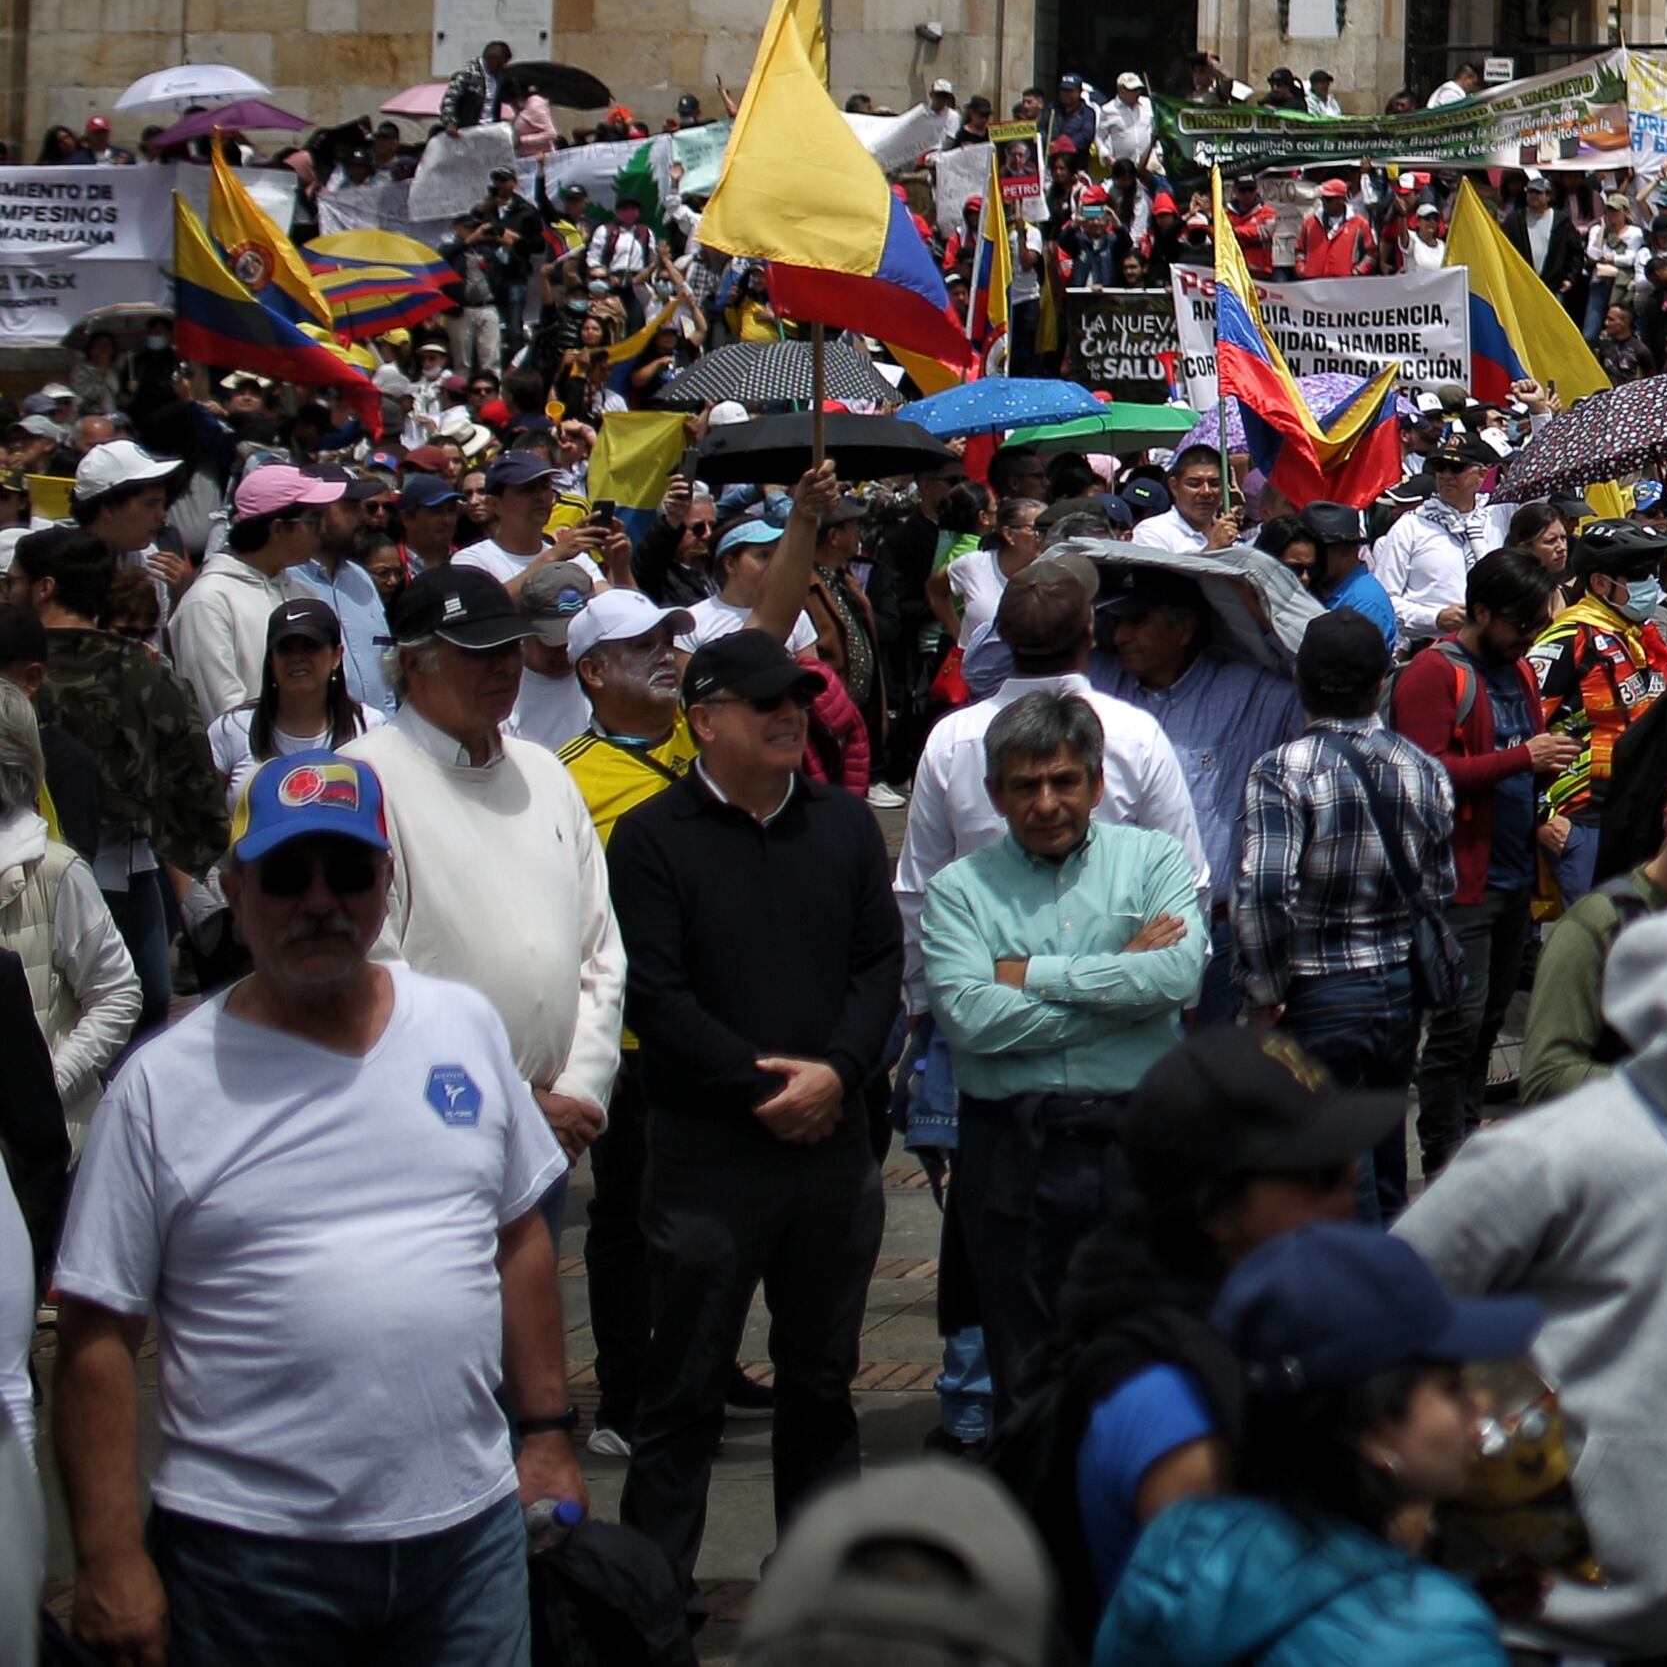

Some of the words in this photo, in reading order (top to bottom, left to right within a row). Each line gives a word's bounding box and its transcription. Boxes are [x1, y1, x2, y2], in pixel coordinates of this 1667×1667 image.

[1220, 140, 1234, 154] el
[1296, 141, 1320, 153] con
[1408, 128, 1474, 148] Buscamos
[86, 184, 113, 200] DE
[1003, 182, 1039, 197] PETRO
[1081, 314, 1107, 333] LA
[1303, 304, 1450, 329] DELINCUENCIA,
[1338, 332, 1429, 357] HAMBRE,
[1103, 357, 1172, 381] SALU
